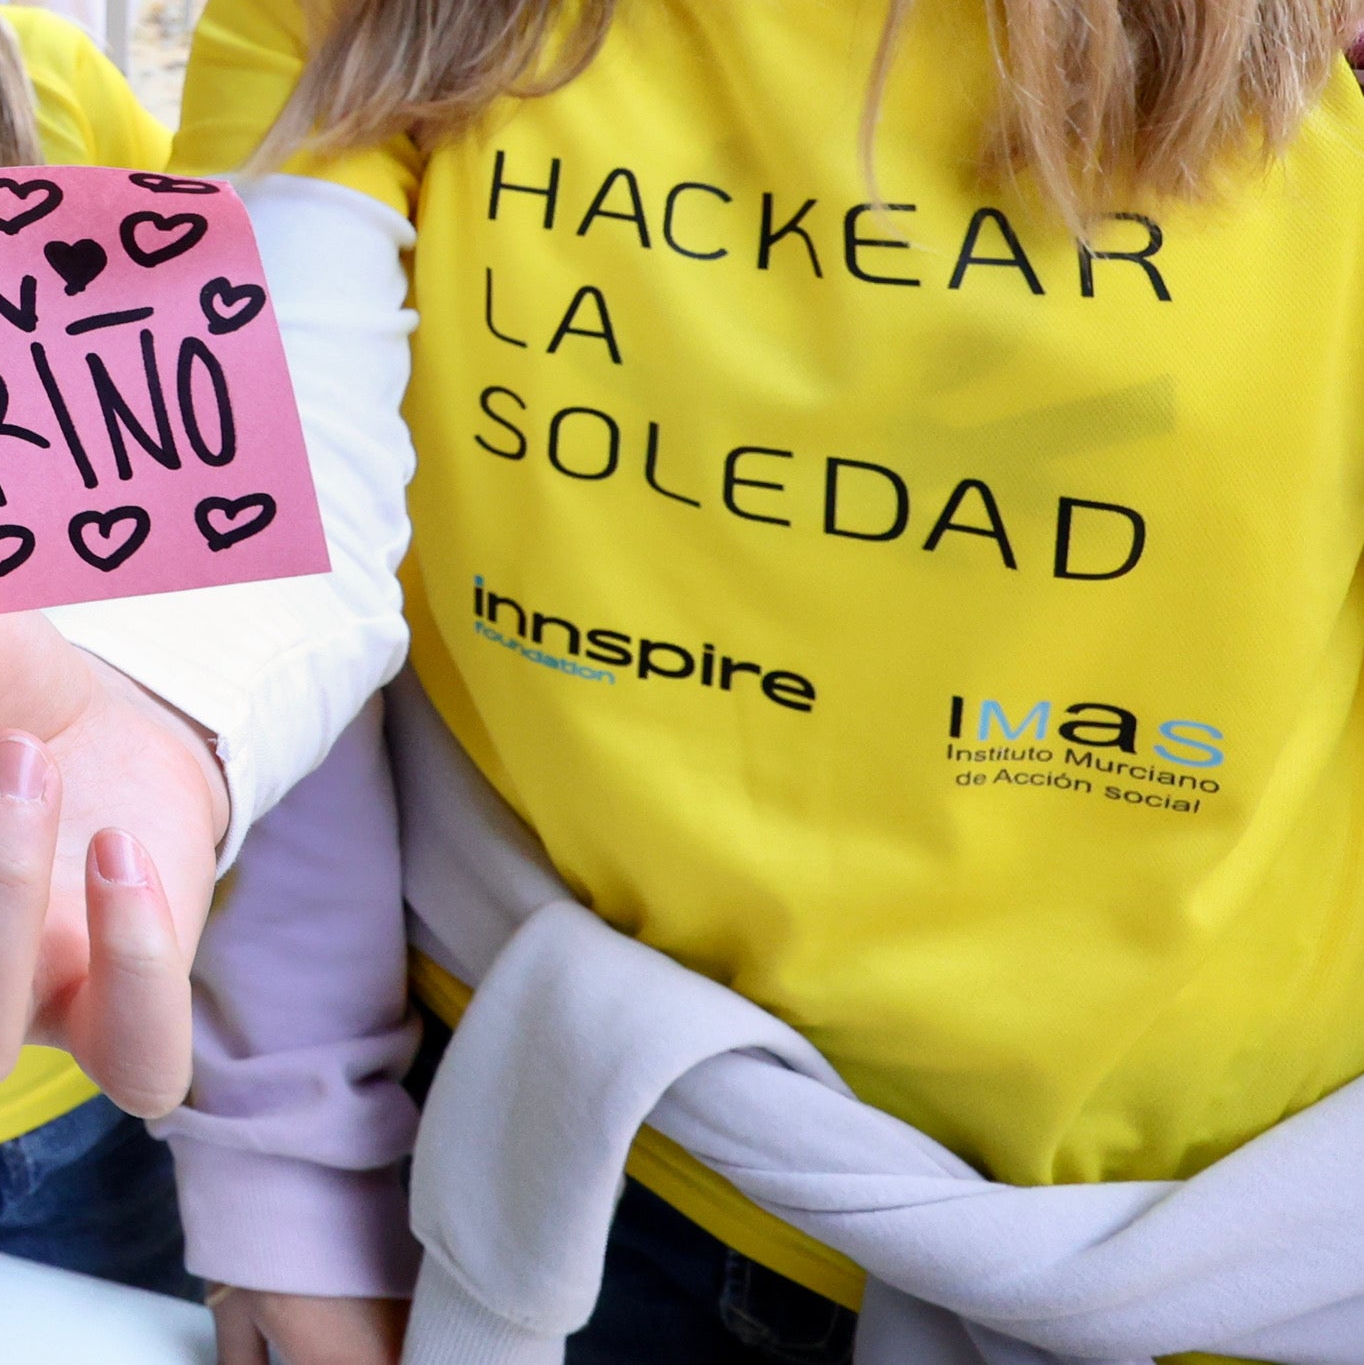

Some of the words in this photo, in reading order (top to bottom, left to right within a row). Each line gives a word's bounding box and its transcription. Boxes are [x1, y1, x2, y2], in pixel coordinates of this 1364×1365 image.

[487, 149, 1174, 303] HACKEAR
[484, 266, 623, 366] LA
[474, 385, 1148, 582] SOLEDAD
[473, 574, 816, 713] innspire
[946, 742, 1053, 762] Instituto
[1064, 747, 1220, 794] Murciano
[955, 770, 986, 787] de
[993, 768, 1092, 794] Acción
[1103, 785, 1201, 814] social
